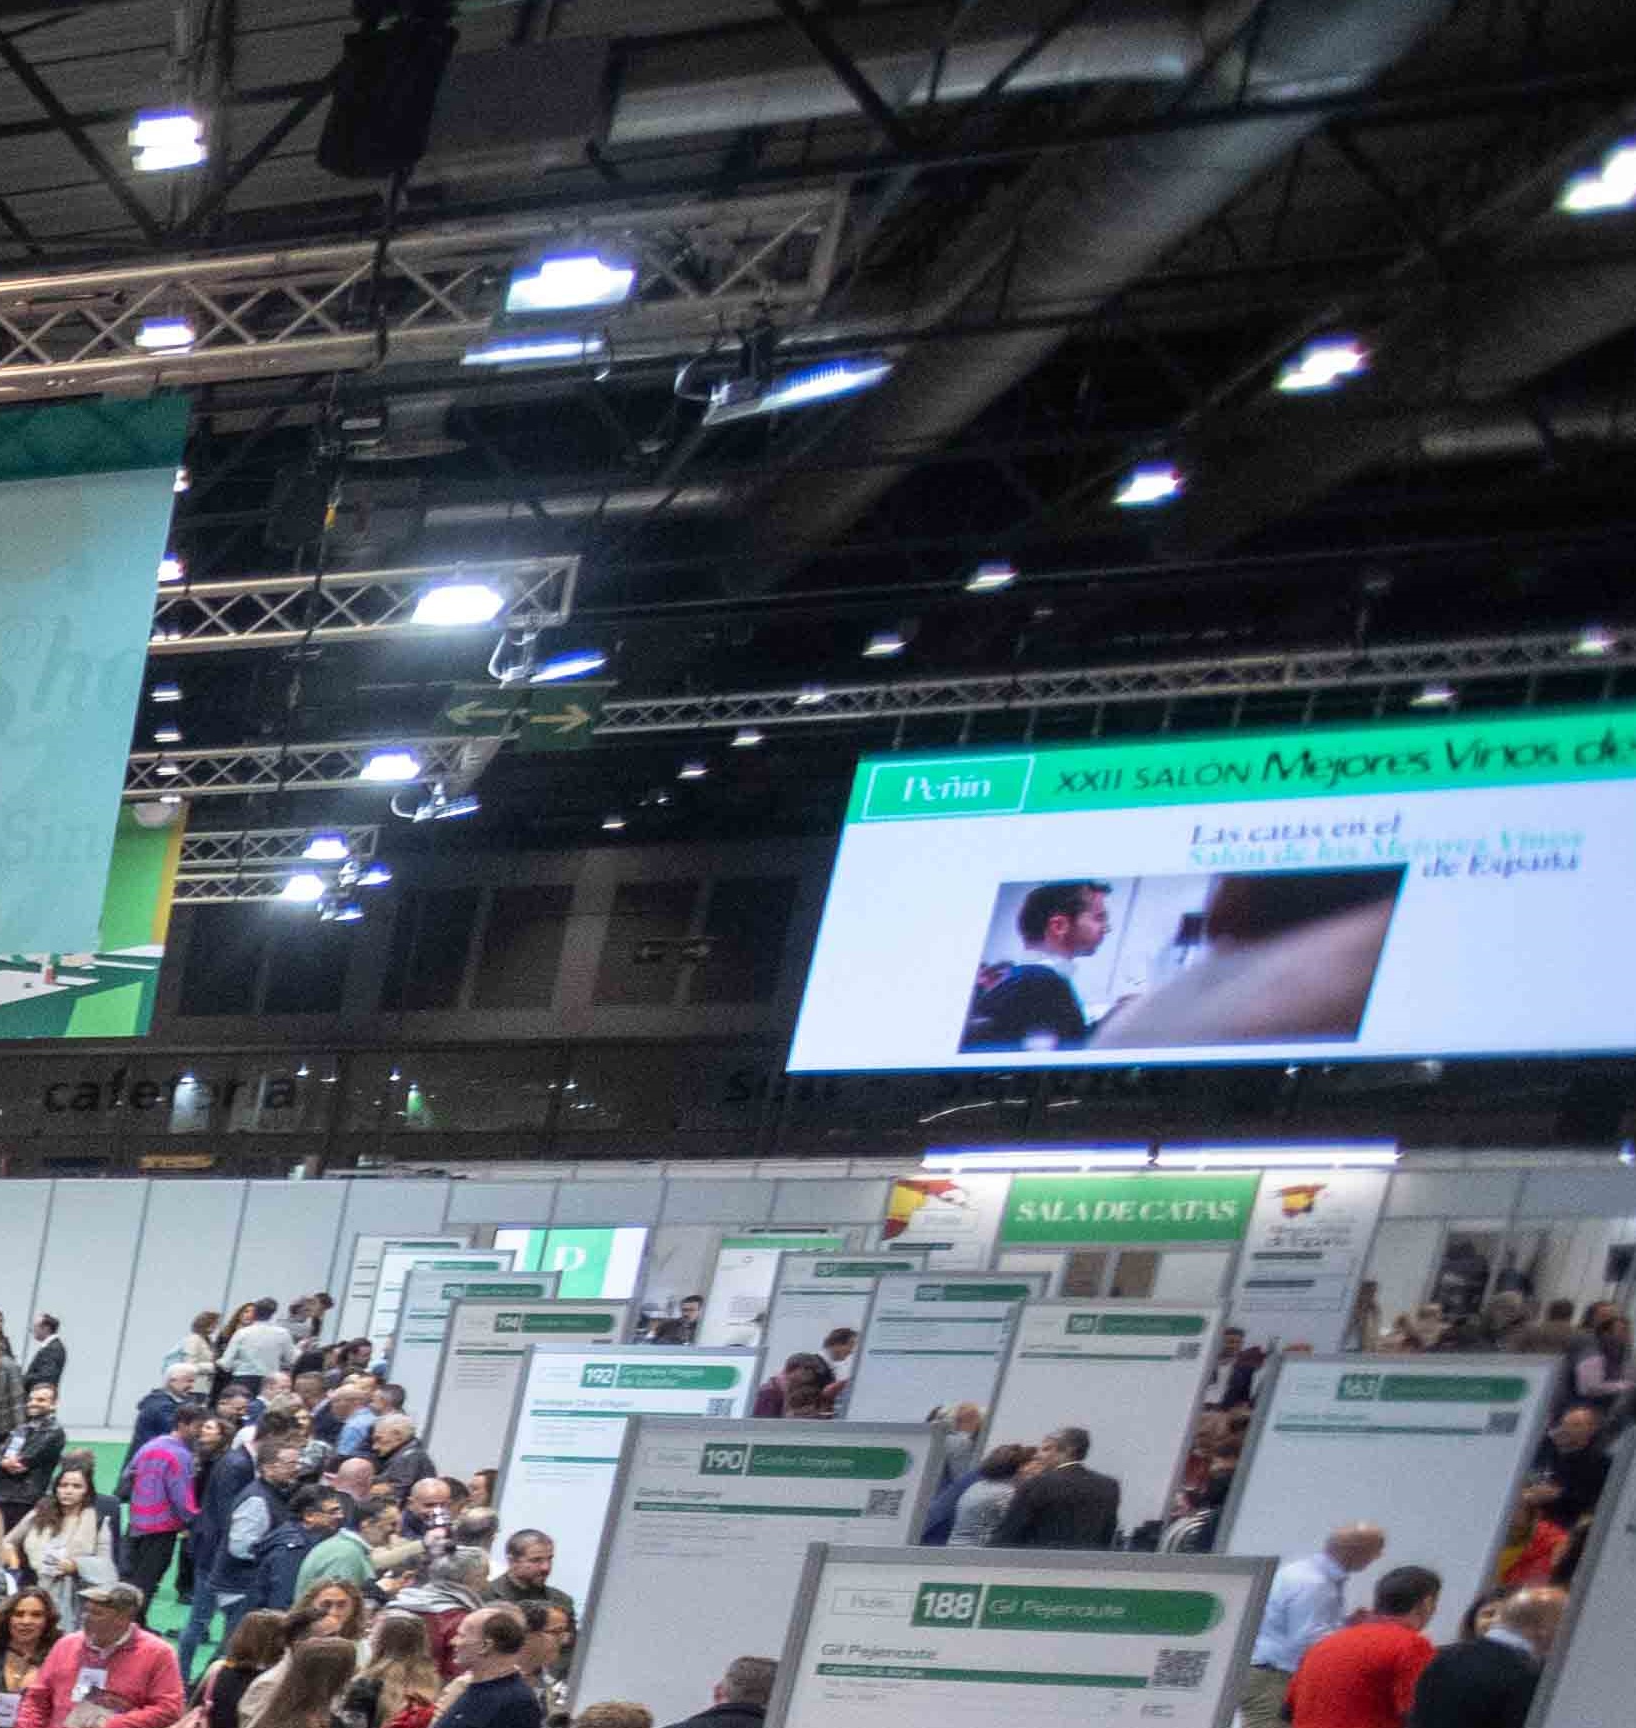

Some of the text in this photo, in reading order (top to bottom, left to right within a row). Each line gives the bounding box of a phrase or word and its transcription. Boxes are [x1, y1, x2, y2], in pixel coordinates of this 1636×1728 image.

[1057, 767, 1123, 793] XXII
[1134, 760, 1252, 791] SALÓN
[1263, 747, 1434, 789] Mejores
[1445, 738, 1559, 775] Vinos
[902, 775, 992, 802] Peñín
[1373, 812, 1402, 836] el
[1015, 1198, 1239, 1222] SALA DE CATAS
[586, 1367, 616, 1385] 192
[704, 1450, 744, 1470] 190
[923, 1592, 975, 1619] 188
